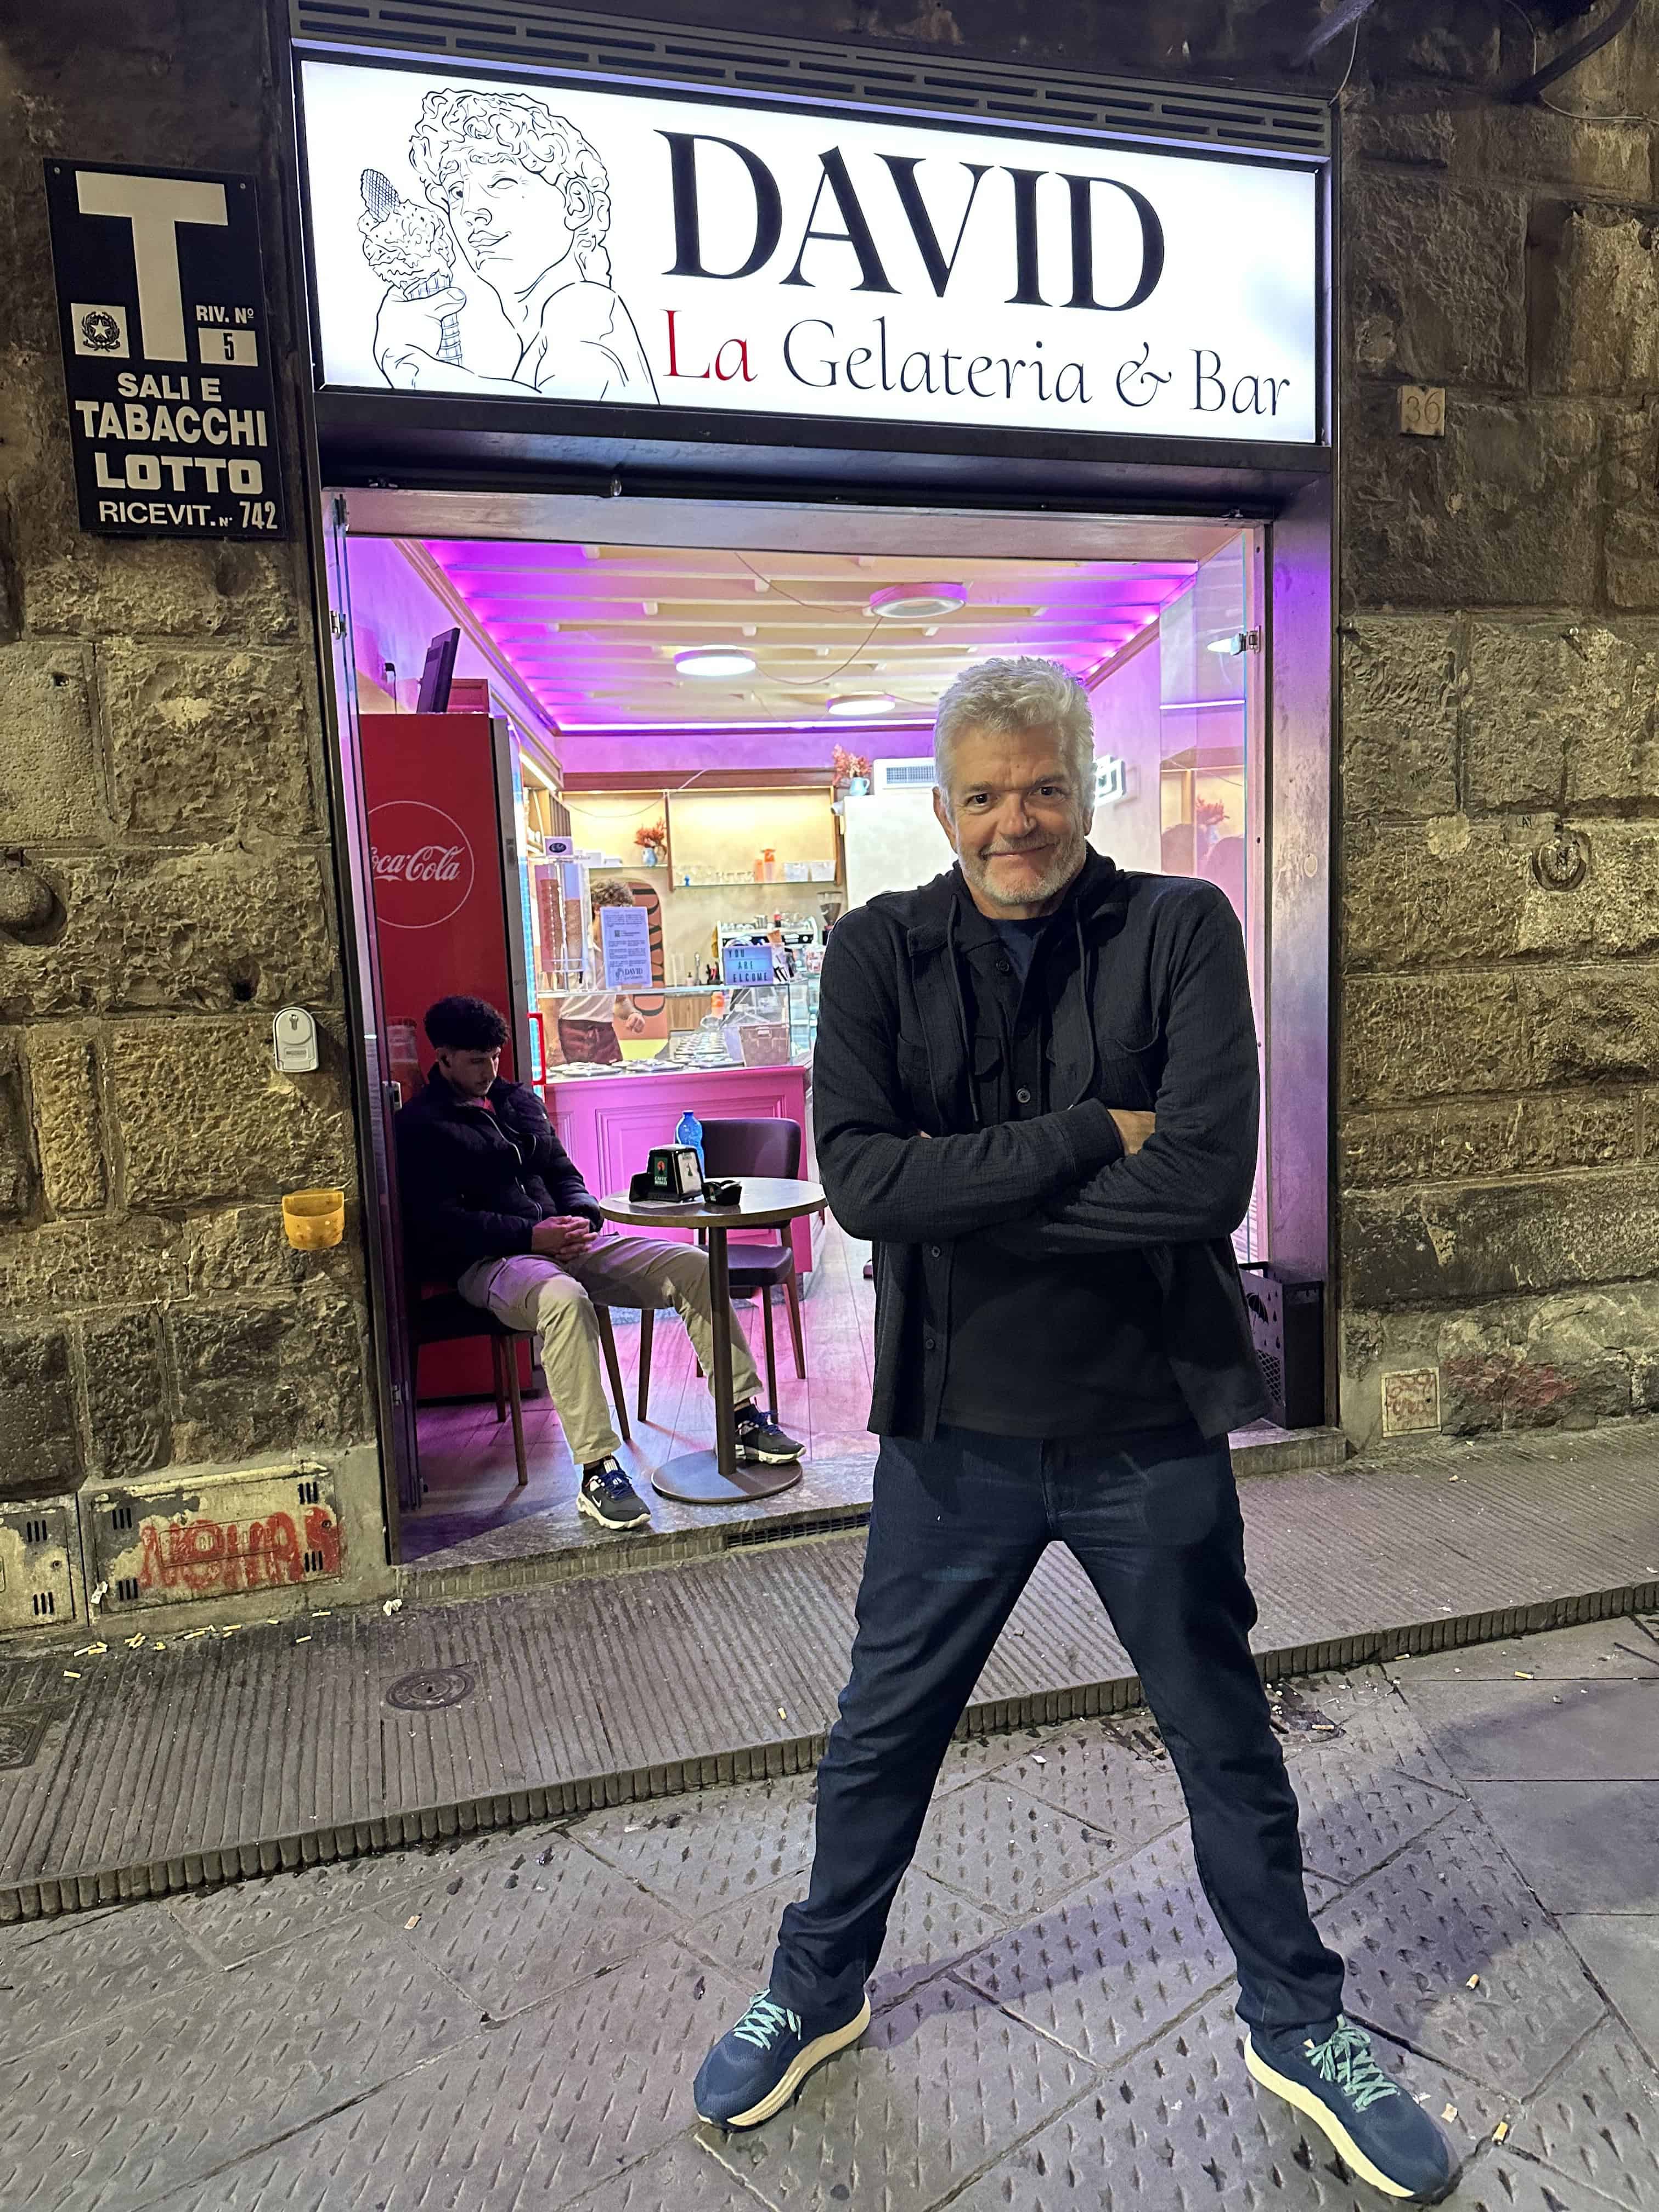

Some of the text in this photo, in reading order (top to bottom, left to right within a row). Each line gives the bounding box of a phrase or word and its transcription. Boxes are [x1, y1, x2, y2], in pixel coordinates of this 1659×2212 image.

[653, 129, 1165, 312] DAVID
[75, 171, 229, 363] T
[196, 304, 230, 323] RIV.
[223, 332, 235, 360] 5
[663, 309, 1291, 416] La Gelateria & Bar
[117, 373, 222, 402] SALI E
[75, 400, 268, 447] TABACCHI
[1406, 391, 1441, 425] 36
[94, 452, 263, 494] LOTTO
[99, 501, 216, 526] RICEVIT.
[239, 501, 278, 529] 742
[371, 845, 465, 881] oca-Cola
[729, 949, 745, 958] YOU
[738, 961, 754, 970] ARE
[624, 967, 643, 975] DAVID
